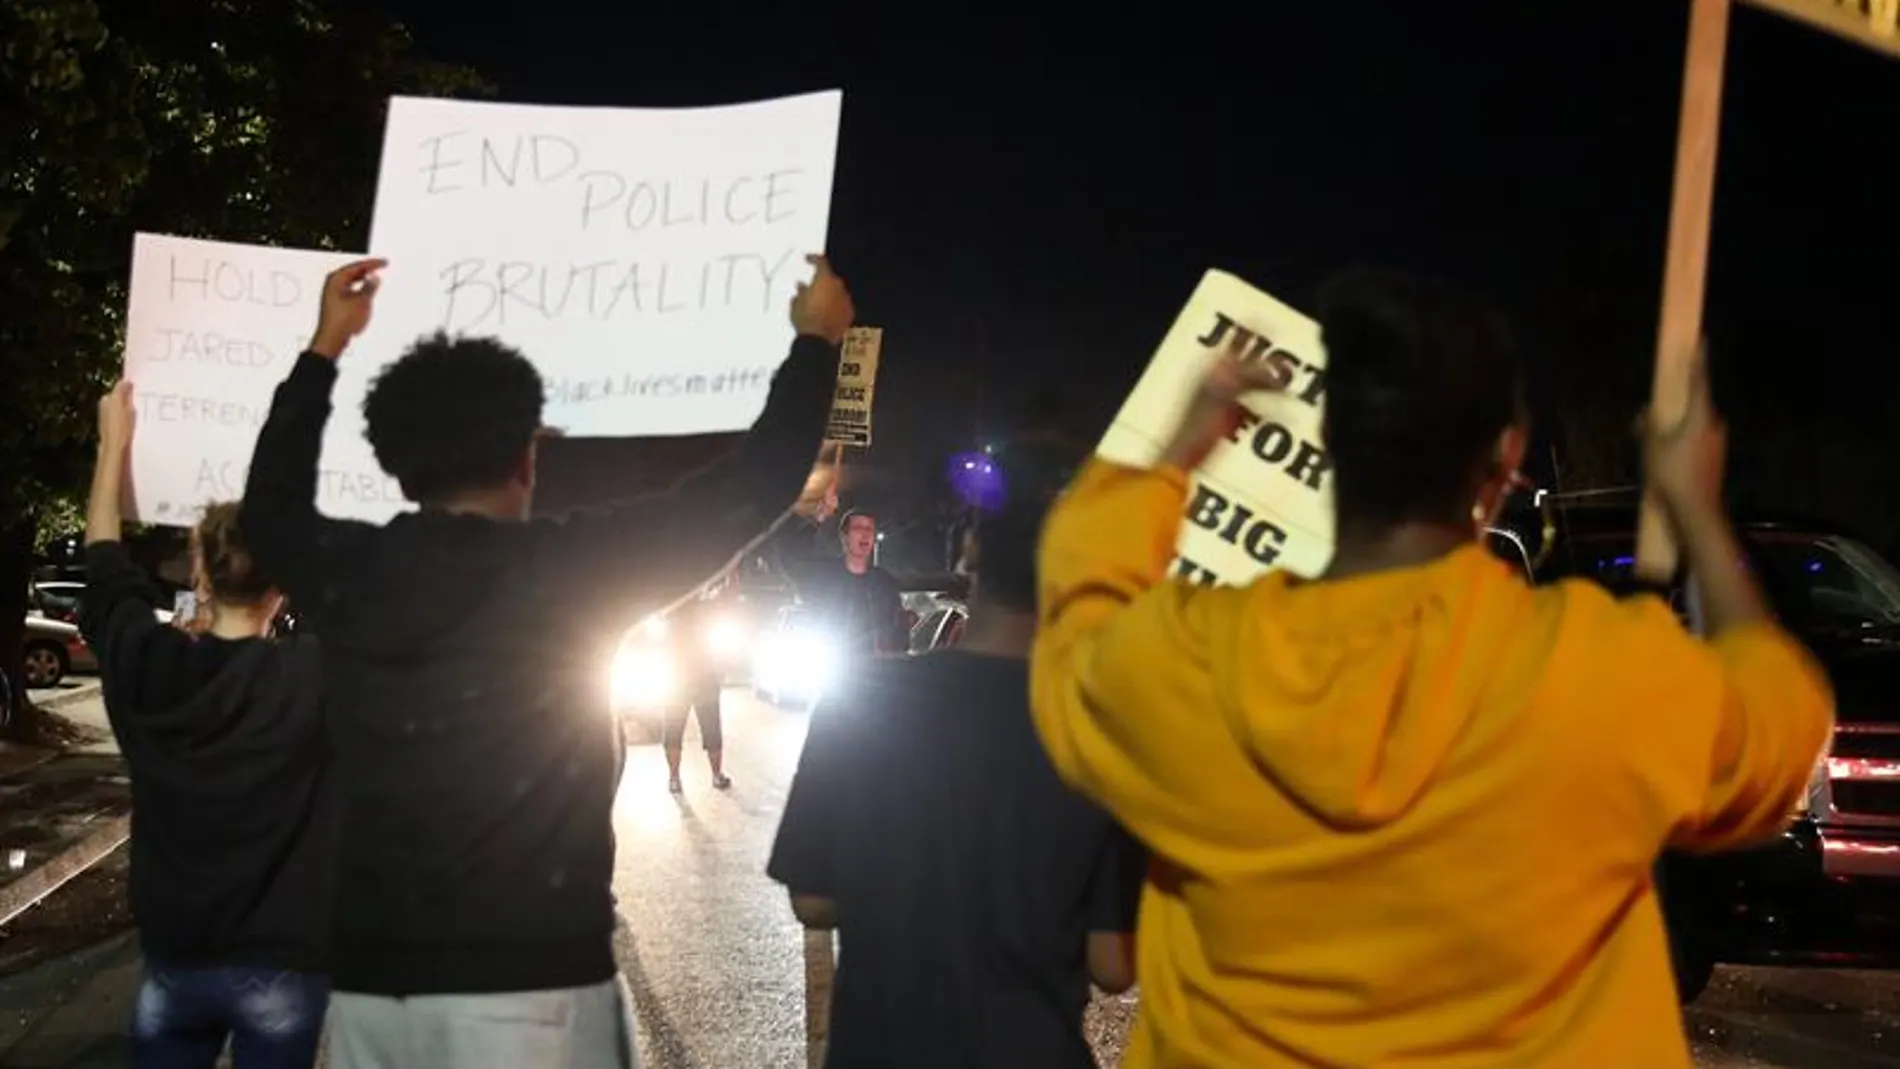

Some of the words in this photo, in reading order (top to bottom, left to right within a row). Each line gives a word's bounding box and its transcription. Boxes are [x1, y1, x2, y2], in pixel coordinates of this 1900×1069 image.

[418, 131, 580, 194] END
[577, 168, 805, 231] POLICE
[170, 254, 301, 308] HOLD
[439, 247, 797, 332] BRUTALITY
[148, 326, 273, 369] JARED
[1196, 310, 1328, 407] JUST
[136, 391, 264, 427] TERREN
[544, 365, 771, 404] Blacklivesmatte
[1184, 481, 1288, 565] BIG
